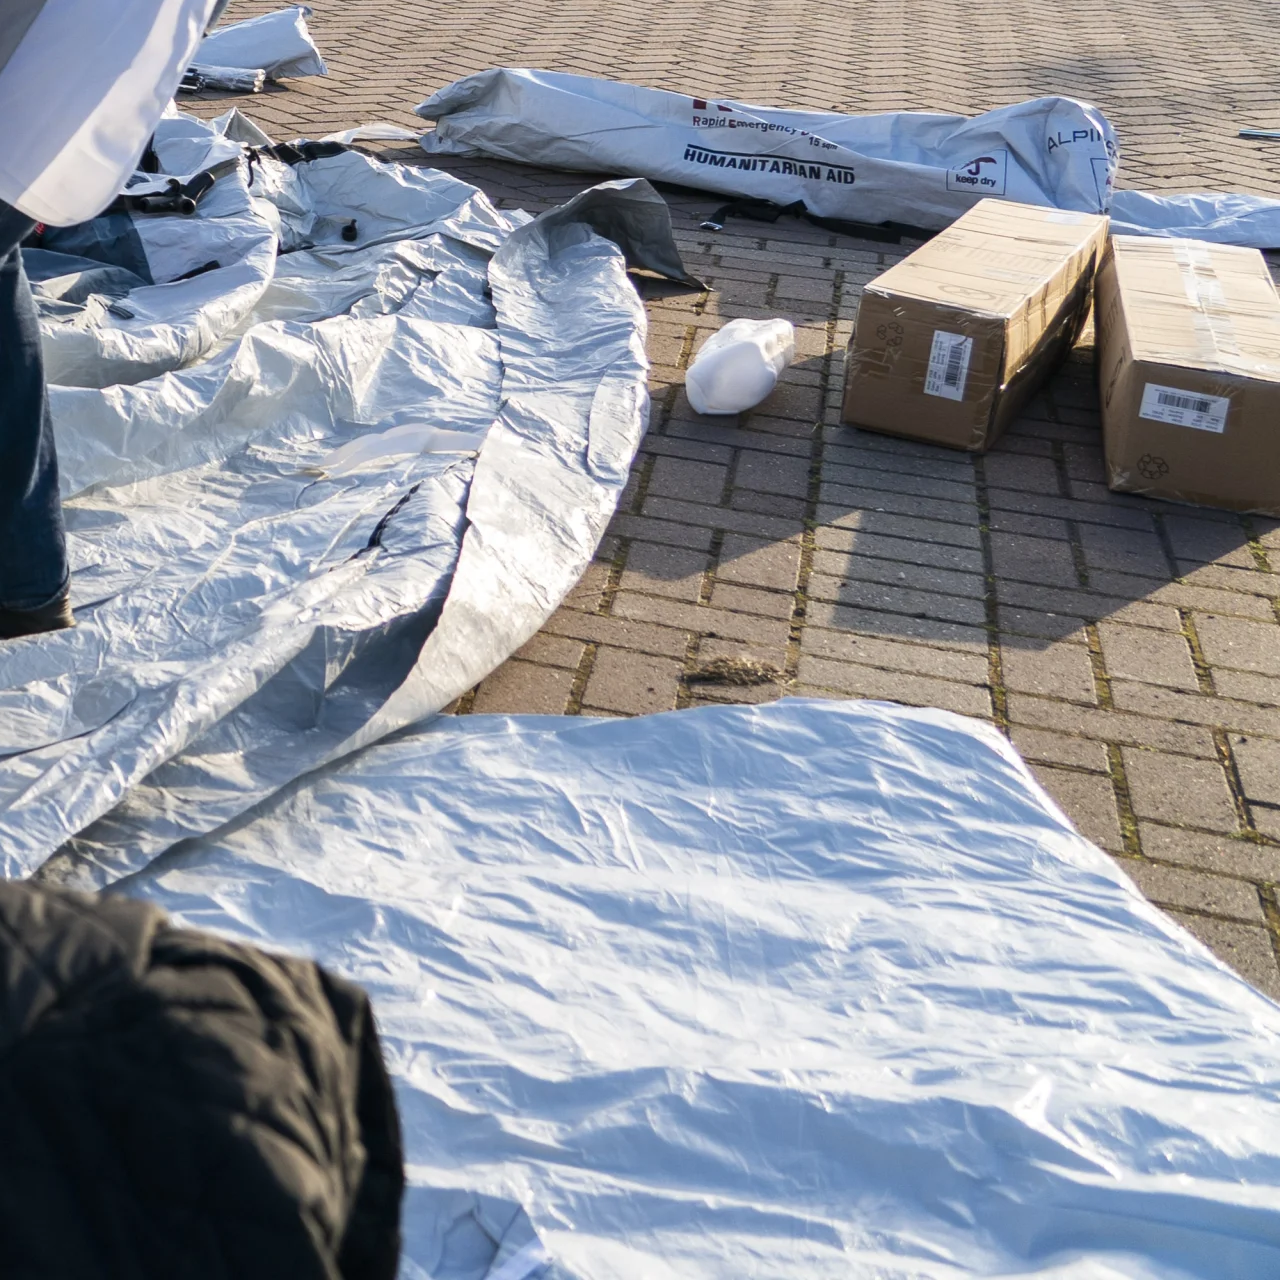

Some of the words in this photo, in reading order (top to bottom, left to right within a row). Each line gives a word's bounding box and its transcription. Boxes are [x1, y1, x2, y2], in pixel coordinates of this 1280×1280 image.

[692, 115, 726, 128] Rapid
[728, 119, 798, 135] Emergency
[808, 136, 820, 147] 15
[821, 141, 838, 150] sqm
[683, 147, 821, 180] HUMANITARIAN
[826, 168, 855, 185] AID
[955, 174, 978, 186] keep
[980, 176, 996, 188] dry
